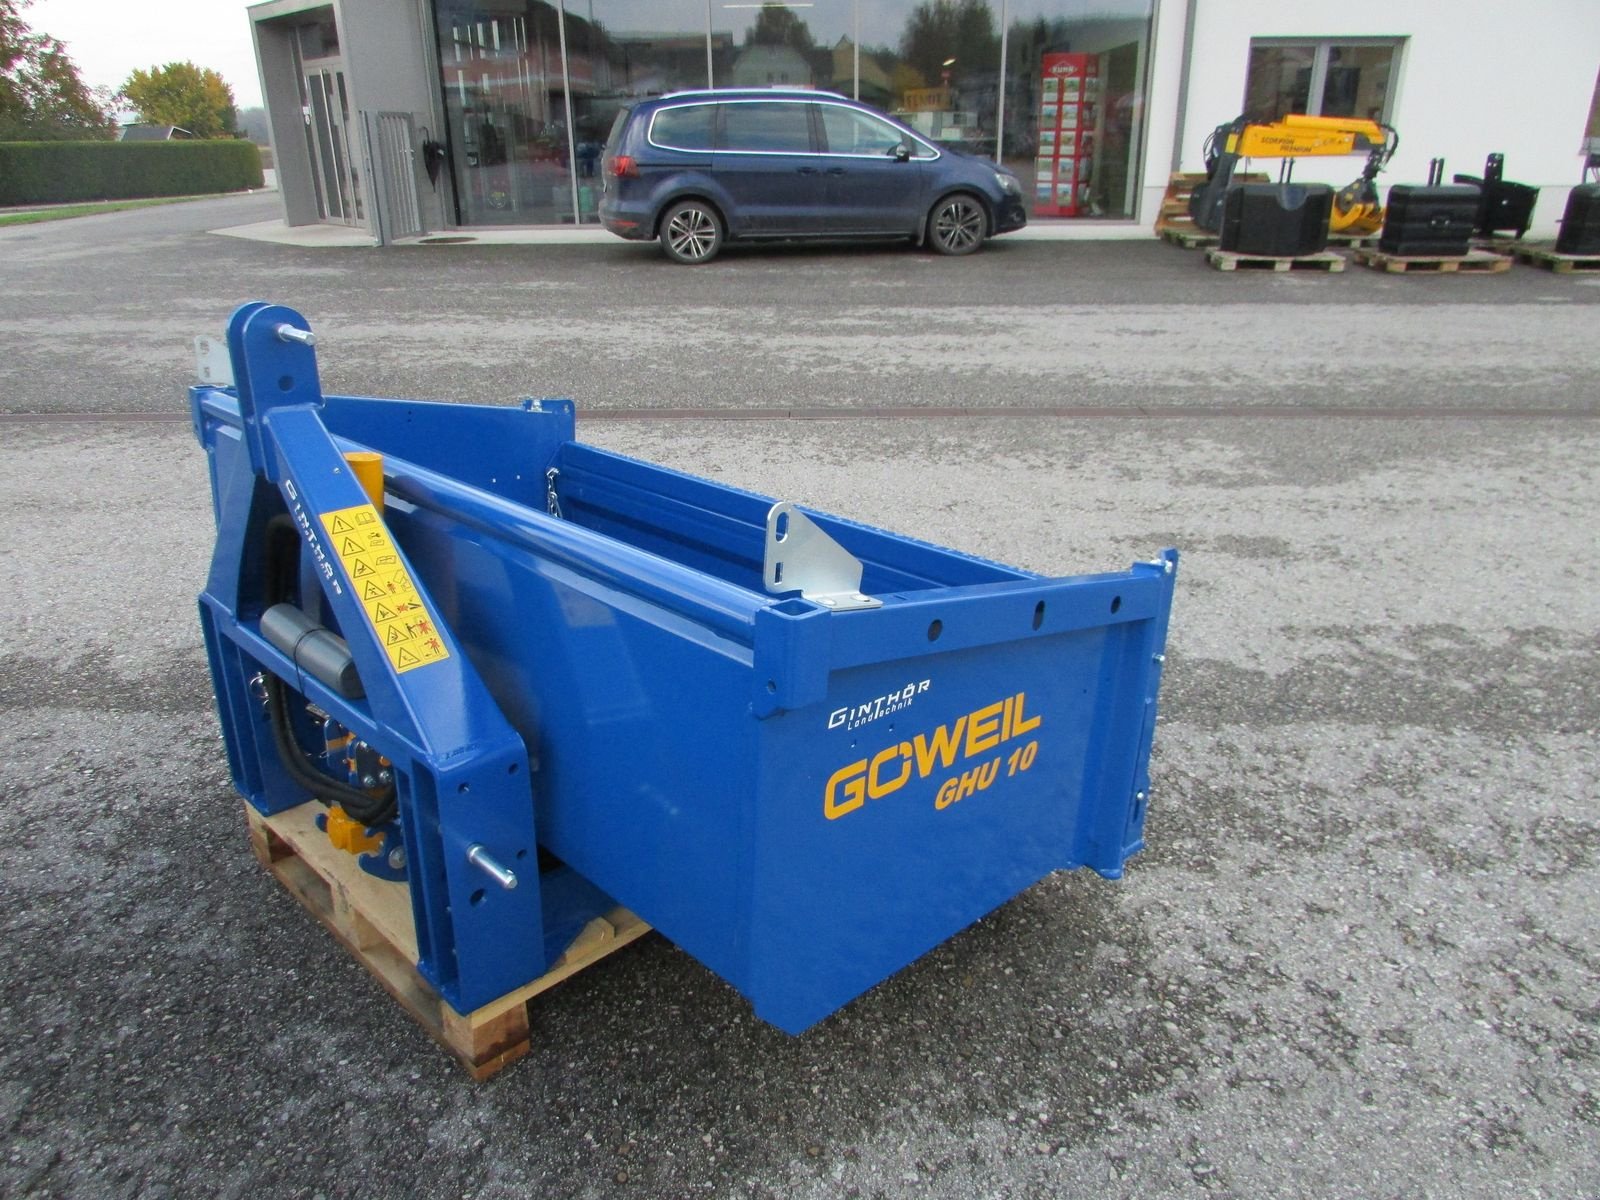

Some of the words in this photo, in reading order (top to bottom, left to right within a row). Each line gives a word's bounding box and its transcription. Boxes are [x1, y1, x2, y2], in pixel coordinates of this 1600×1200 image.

[1261, 136, 1295, 145] SCORPION
[1280, 145, 1312, 153] PREMIUM
[828, 679, 931, 730] GINTHÖR
[935, 757, 1000, 810] GHU
[1008, 740, 1038, 777] 10
